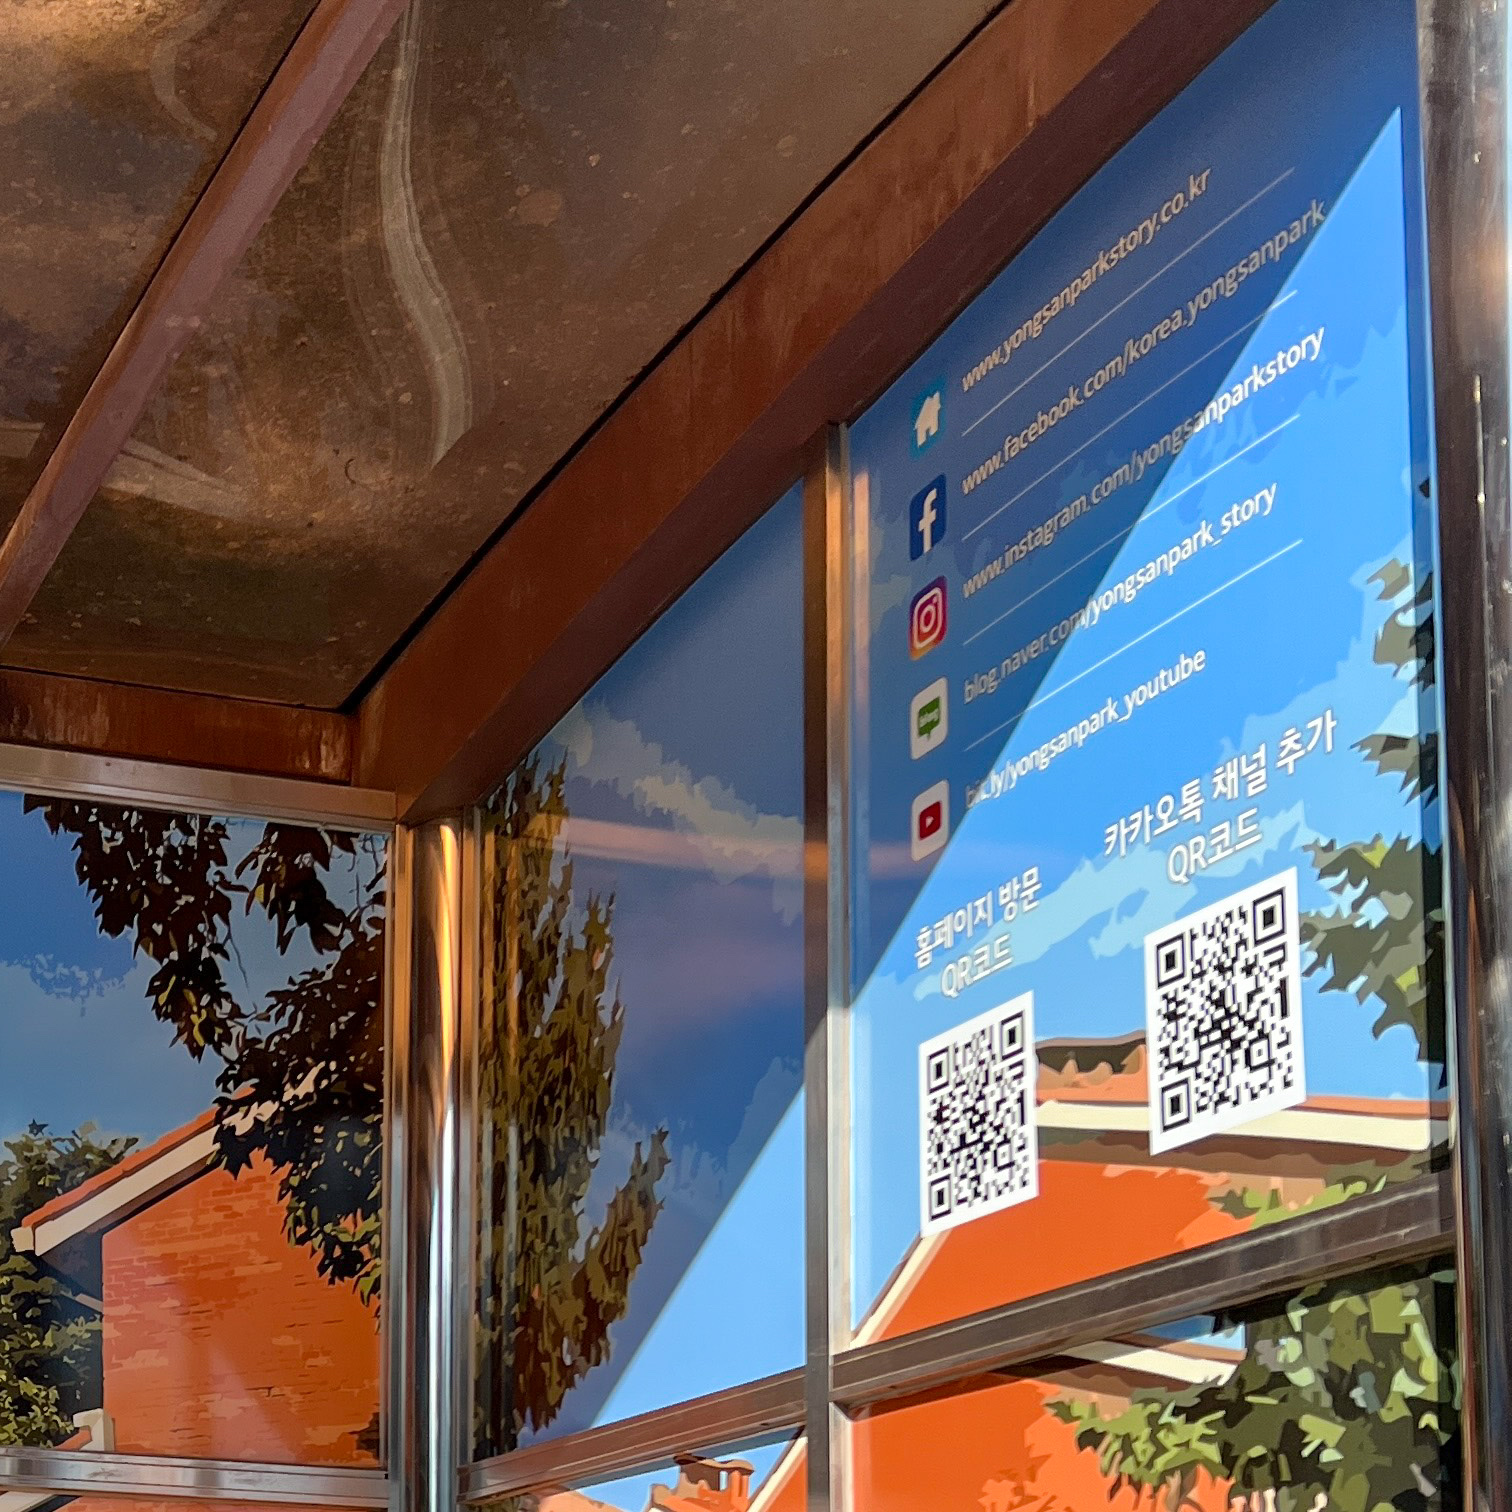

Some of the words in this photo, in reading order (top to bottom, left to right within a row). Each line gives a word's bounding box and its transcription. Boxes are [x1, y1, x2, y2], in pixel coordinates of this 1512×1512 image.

[961, 167, 1211, 393] www.yongsanparkstory.co.kr
[961, 198, 1326, 496] www.facebook.com/korea.yongsanpark
[962, 326, 1325, 599] www.instagram.com/yongsanparkstory
[963, 482, 1278, 705] blog.naver.com/yongsanpark_story
[1103, 778, 1205, 859] 카카오톡
[1211, 742, 1269, 803] 채널
[1275, 708, 1338, 777] 추가
[1166, 807, 1263, 885] QR코드
[913, 889, 994, 970] 홈페이지
[997, 865, 1043, 923] 방문
[940, 933, 1015, 999] QR코드
